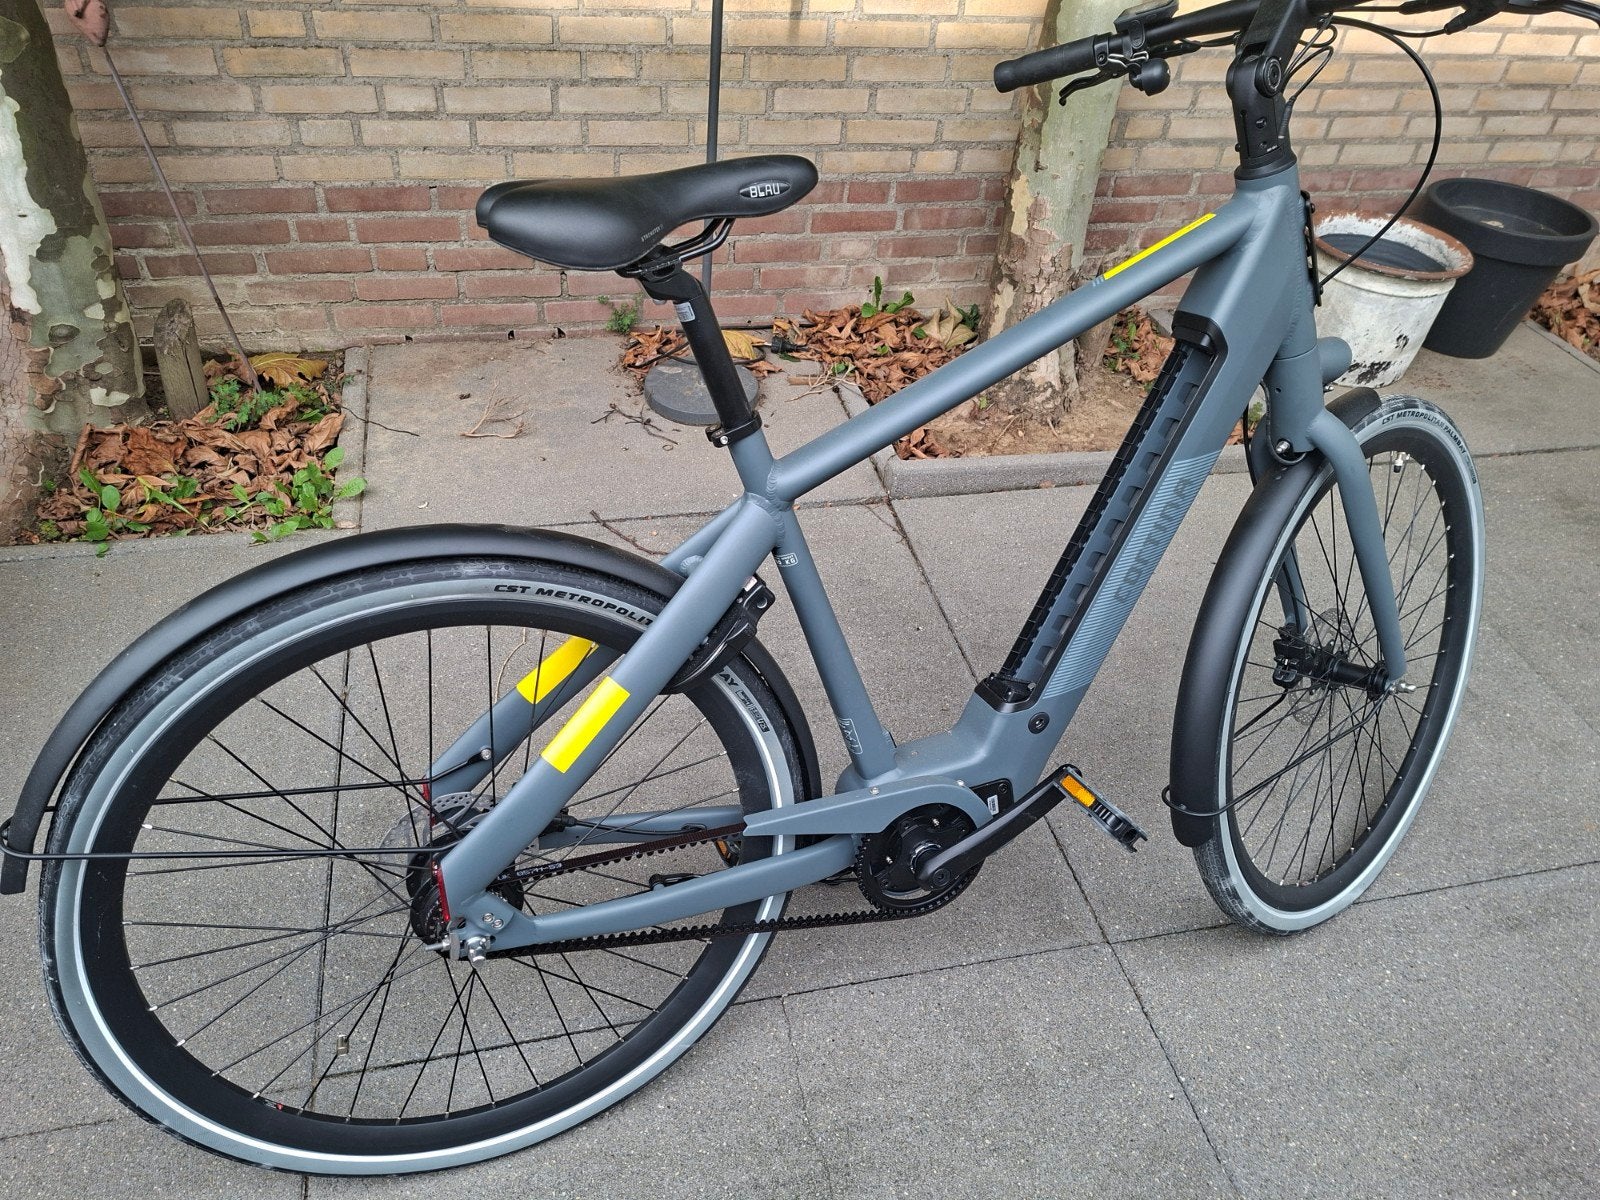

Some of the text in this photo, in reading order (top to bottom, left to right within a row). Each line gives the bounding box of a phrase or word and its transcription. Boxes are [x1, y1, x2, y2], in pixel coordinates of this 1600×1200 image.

[749, 182, 781, 198] BLAU
[1382, 410, 1467, 454] CST METROPOLITAN PALMBAY
[493, 584, 654, 627] CST METROPOLIT
